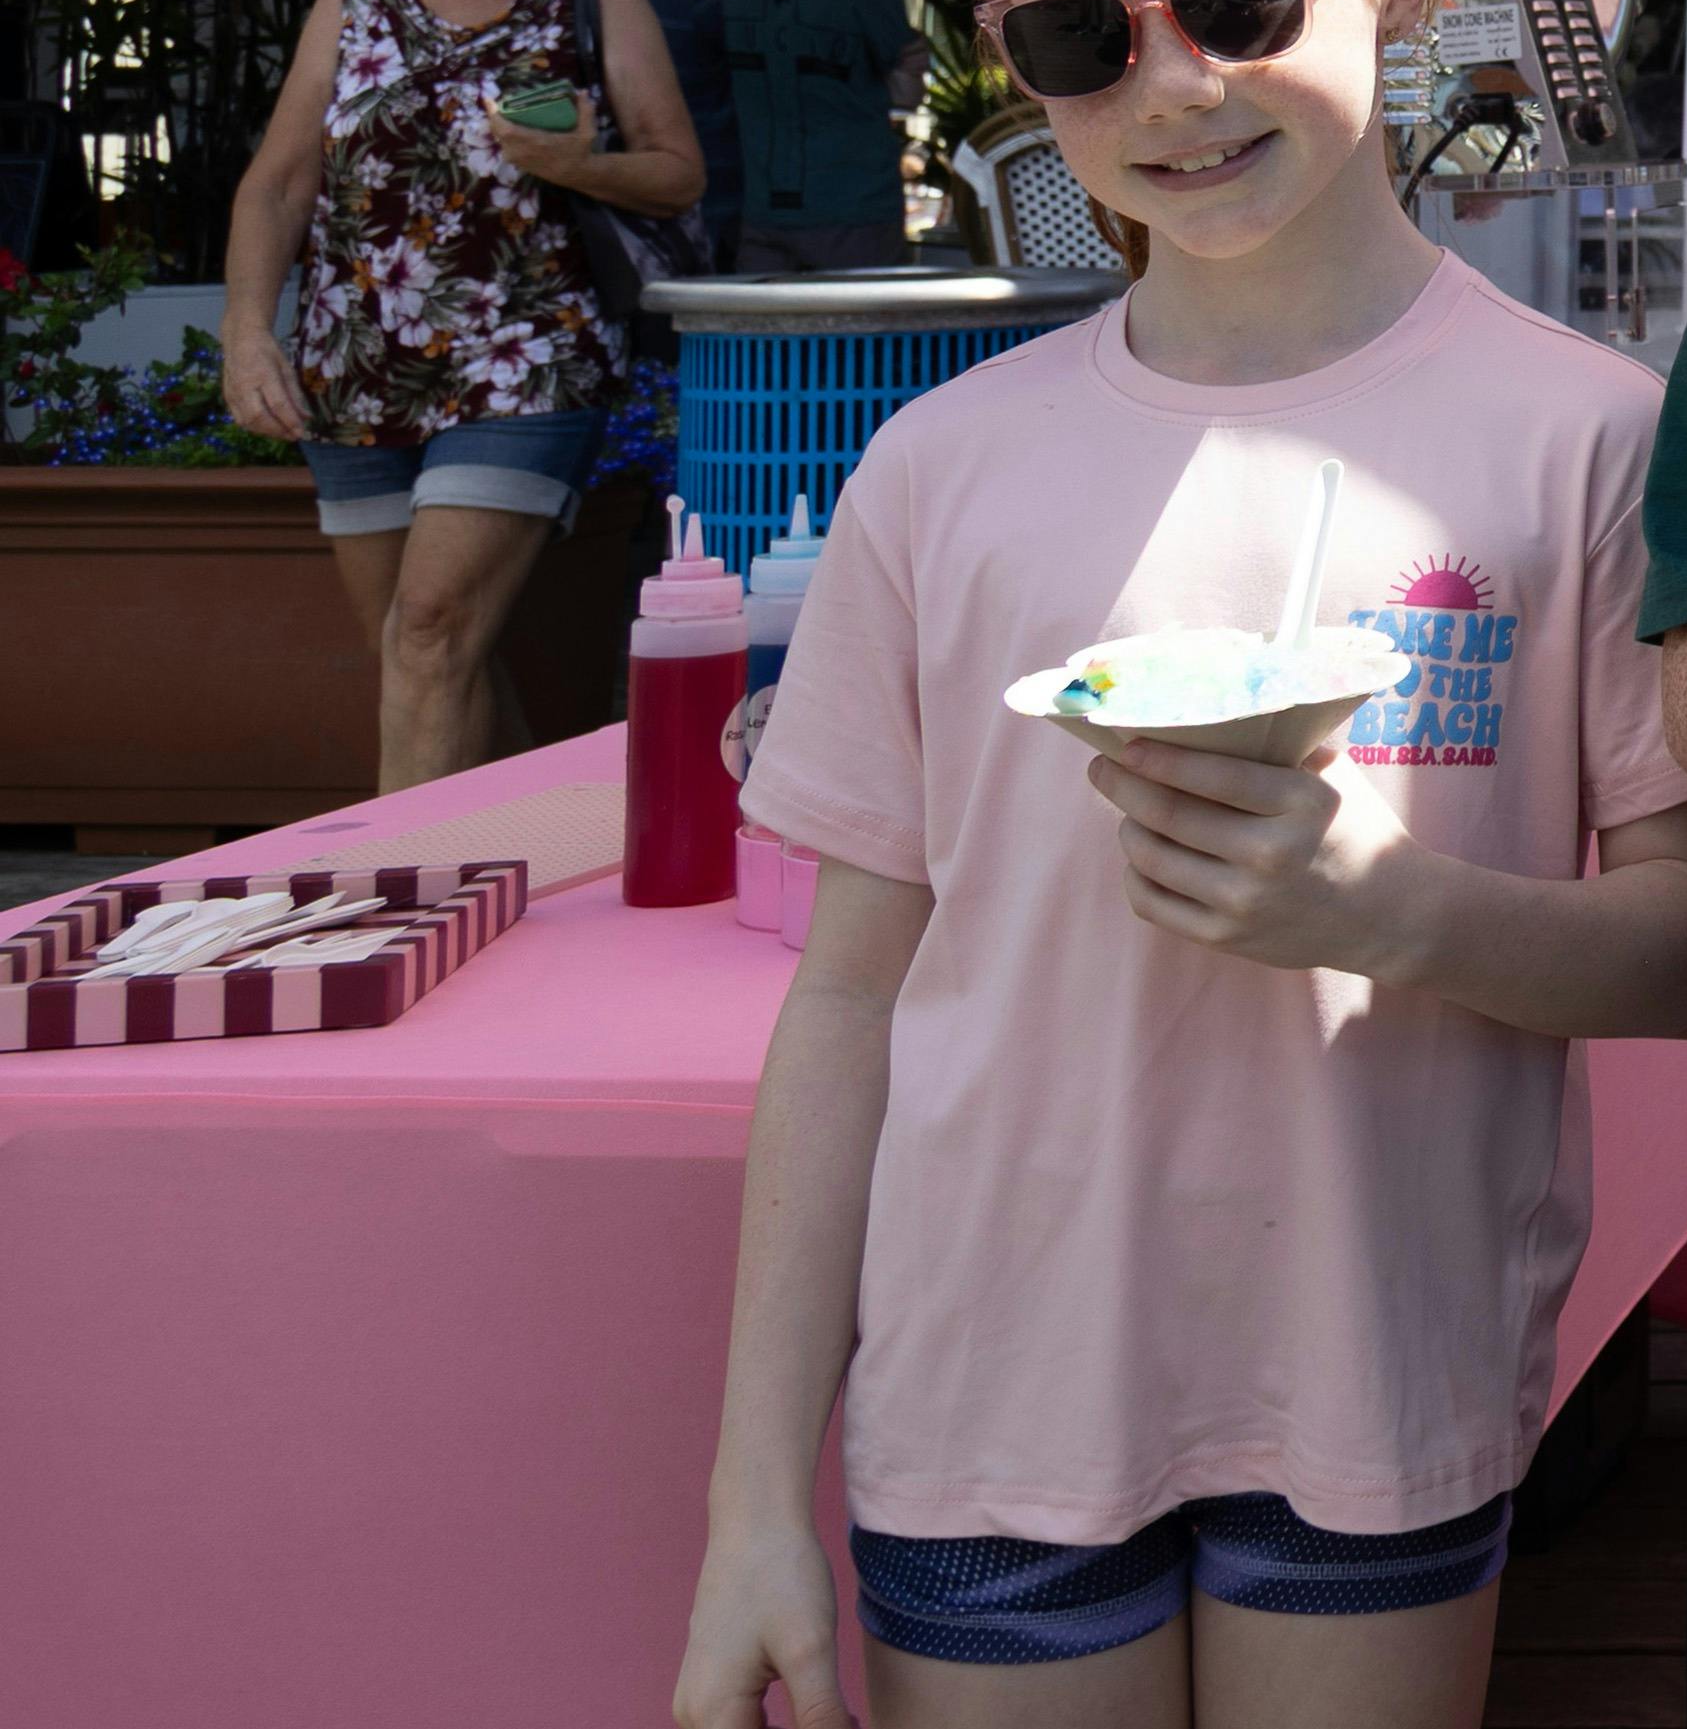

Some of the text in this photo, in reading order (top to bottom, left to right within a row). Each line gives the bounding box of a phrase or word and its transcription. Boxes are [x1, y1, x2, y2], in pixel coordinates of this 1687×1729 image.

[1459, 613, 1520, 664] ME
[1427, 663, 1494, 703] THE
[1347, 701, 1504, 748] BEACH
